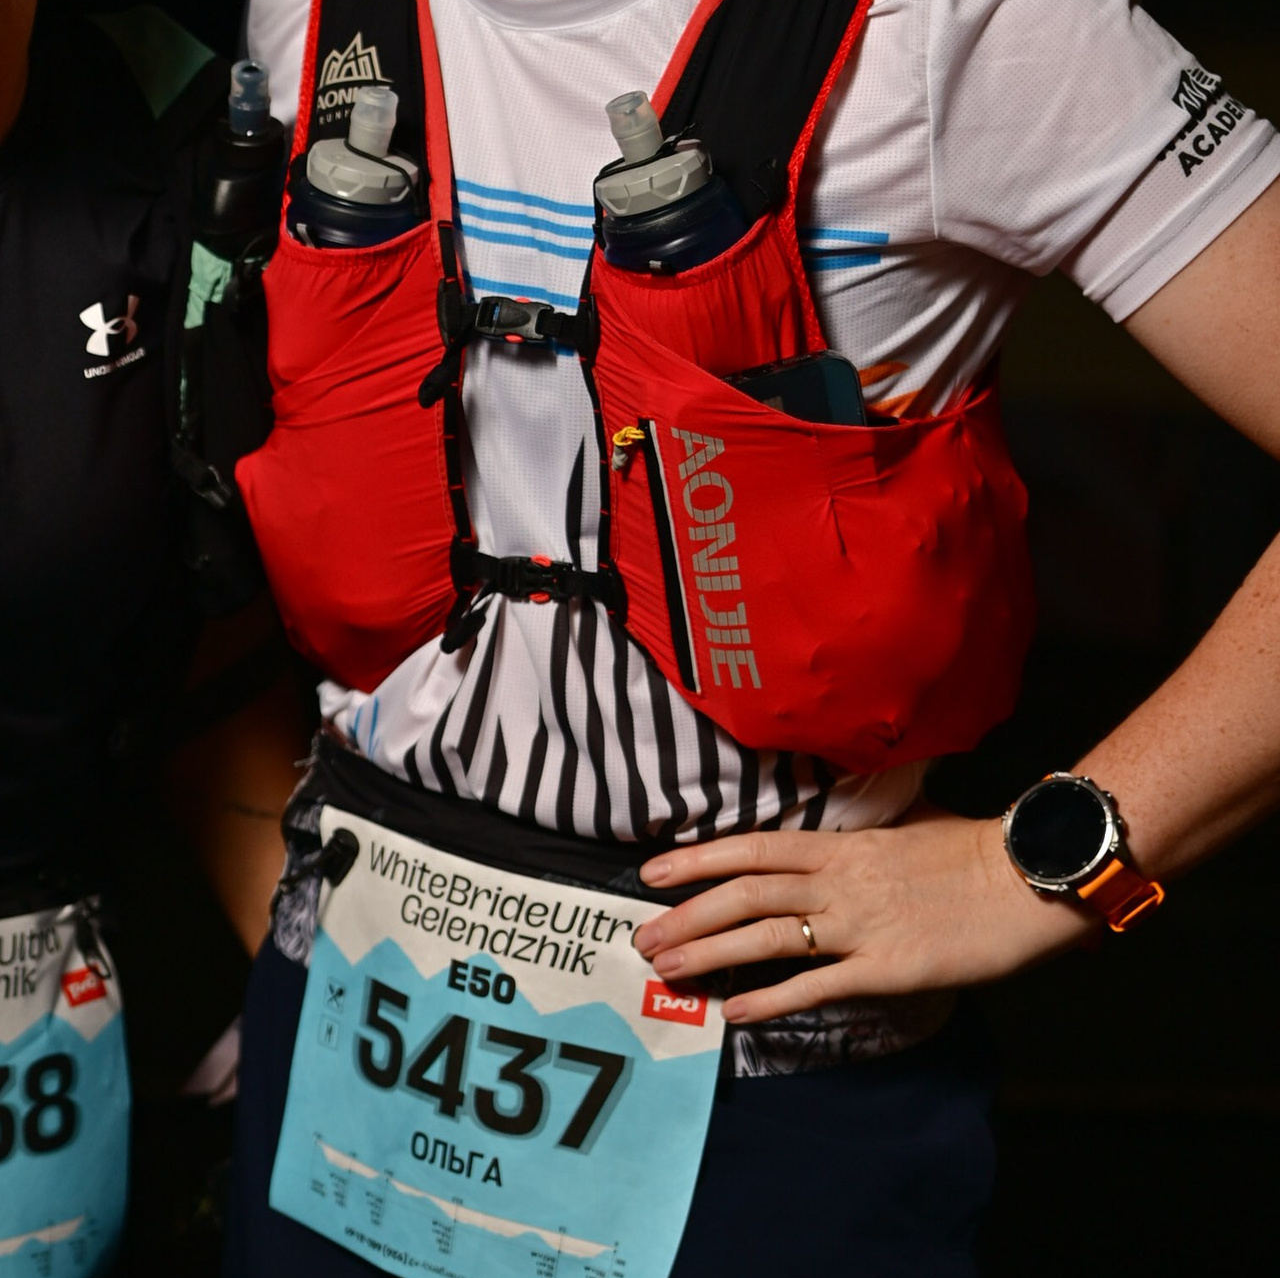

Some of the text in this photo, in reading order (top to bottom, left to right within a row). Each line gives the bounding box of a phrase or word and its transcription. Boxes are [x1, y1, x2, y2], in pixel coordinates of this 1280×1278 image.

[317, 86, 360, 110] AONI
[83, 362, 114, 379] UNDE
[671, 426, 762, 690] AONIJIE
[370, 840, 641, 948] WhiteBrideUltr
[401, 894, 596, 976] Gelendzhik
[447, 959, 517, 1005] E50
[359, 980, 627, 1151] 5437
[410, 1132, 504, 1188] ОЛЬГА
